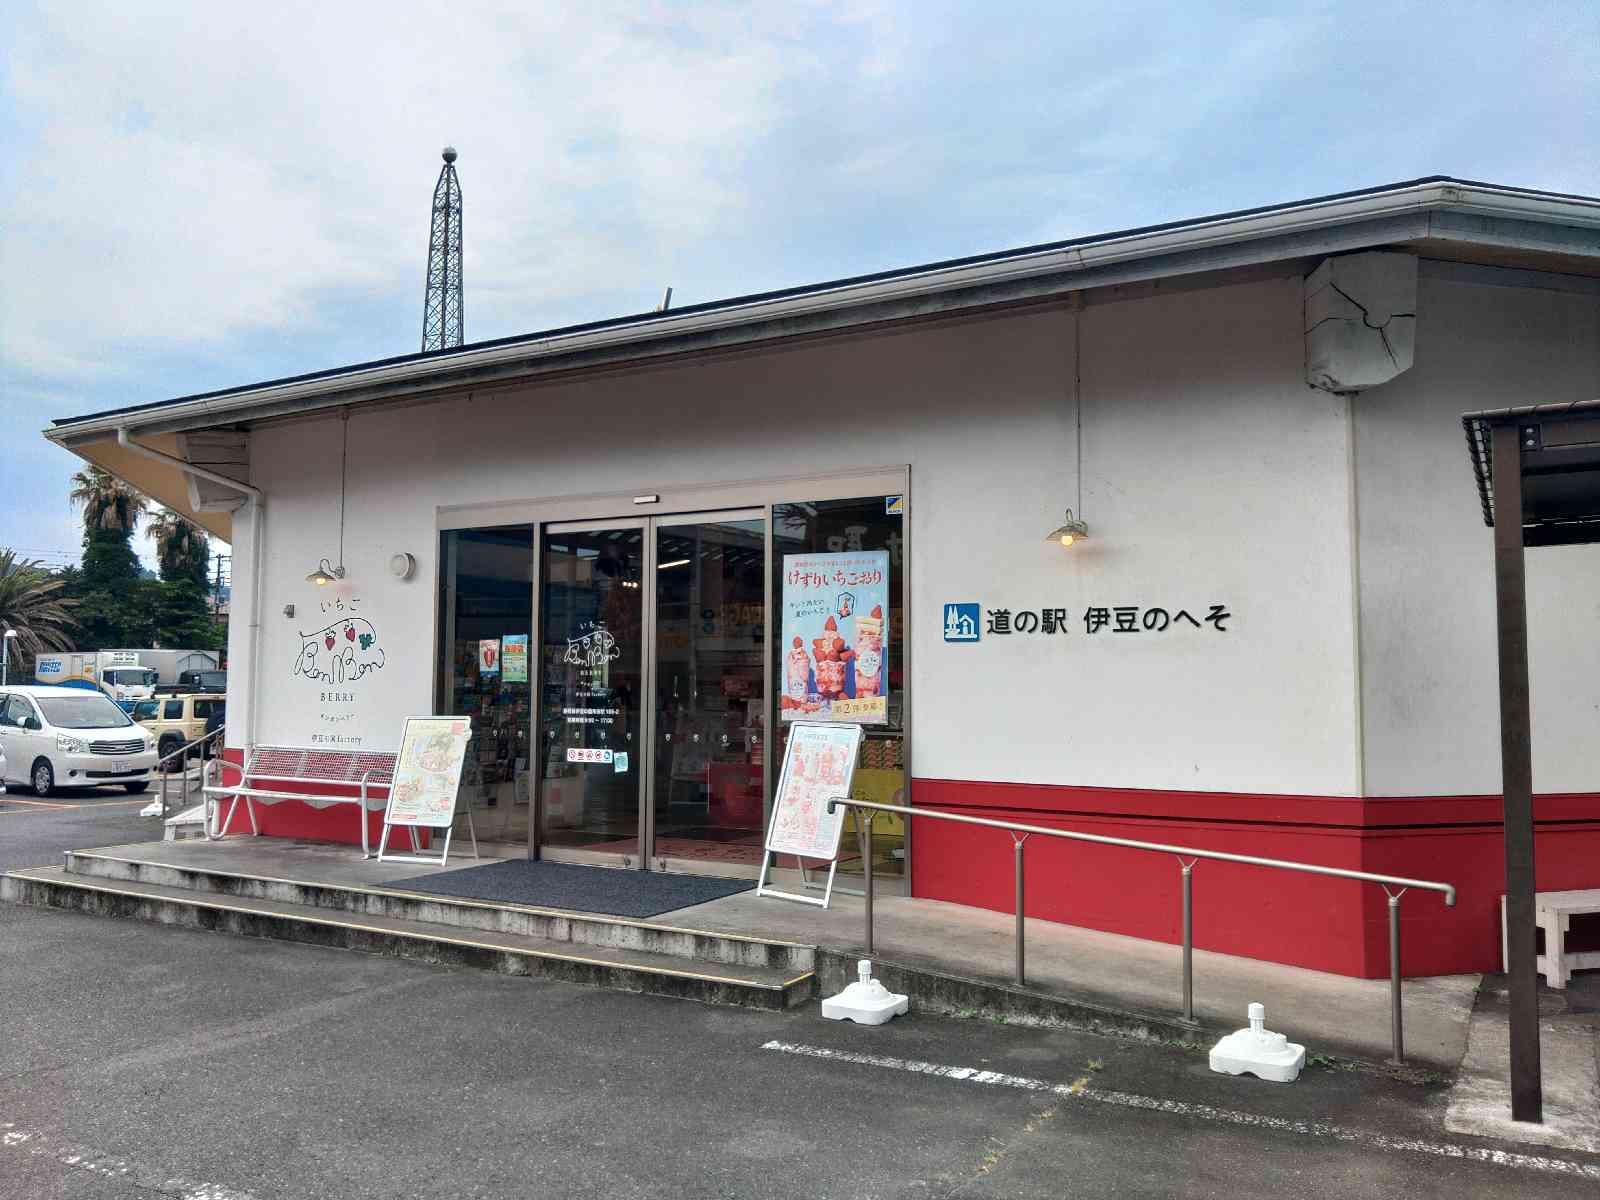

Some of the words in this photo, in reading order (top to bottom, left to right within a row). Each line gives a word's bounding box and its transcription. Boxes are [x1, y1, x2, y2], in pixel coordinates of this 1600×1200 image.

[987, 608, 1068, 635] 道の駅
[1083, 604, 1232, 634] 伊豆のへそ
[320, 692, 355, 702] BERRY
